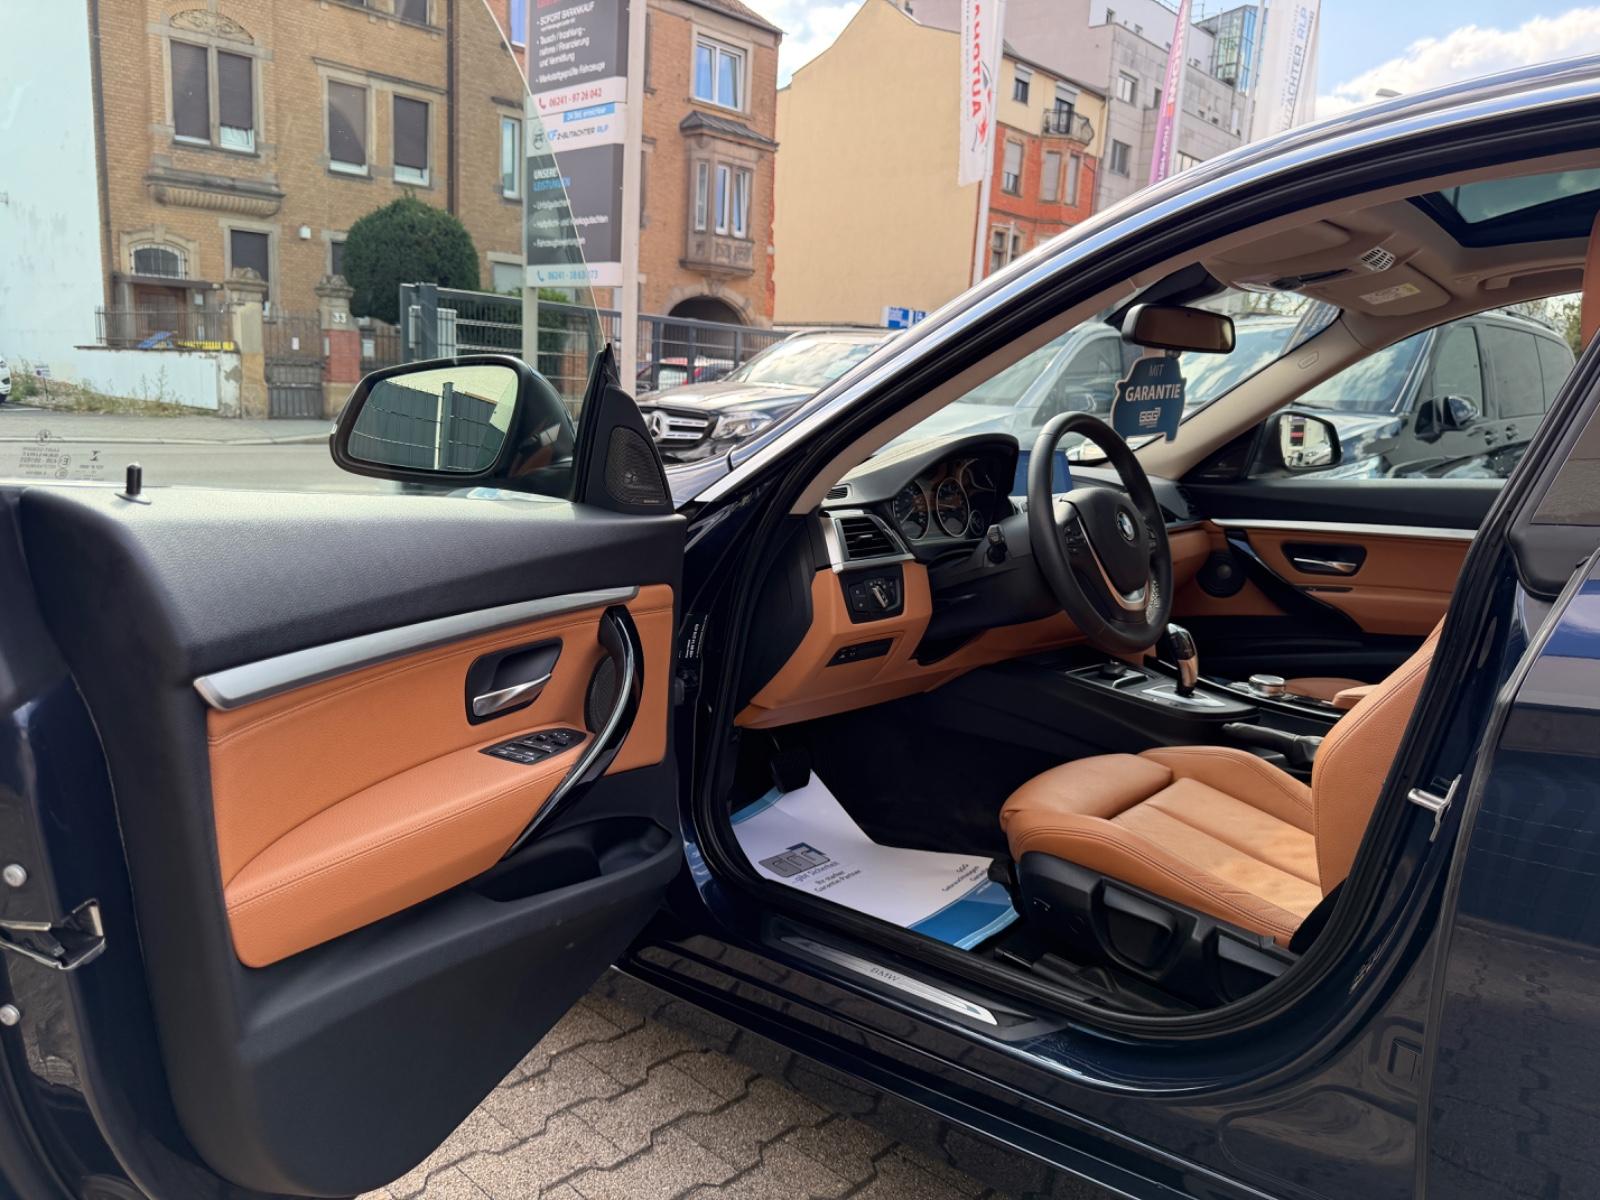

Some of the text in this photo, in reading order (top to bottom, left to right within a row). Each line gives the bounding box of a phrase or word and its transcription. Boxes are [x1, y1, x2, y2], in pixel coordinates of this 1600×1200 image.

[1149, 363, 1165, 376] MIT
[1125, 383, 1182, 402] GARANTIE
[870, 967, 901, 982] BMW
